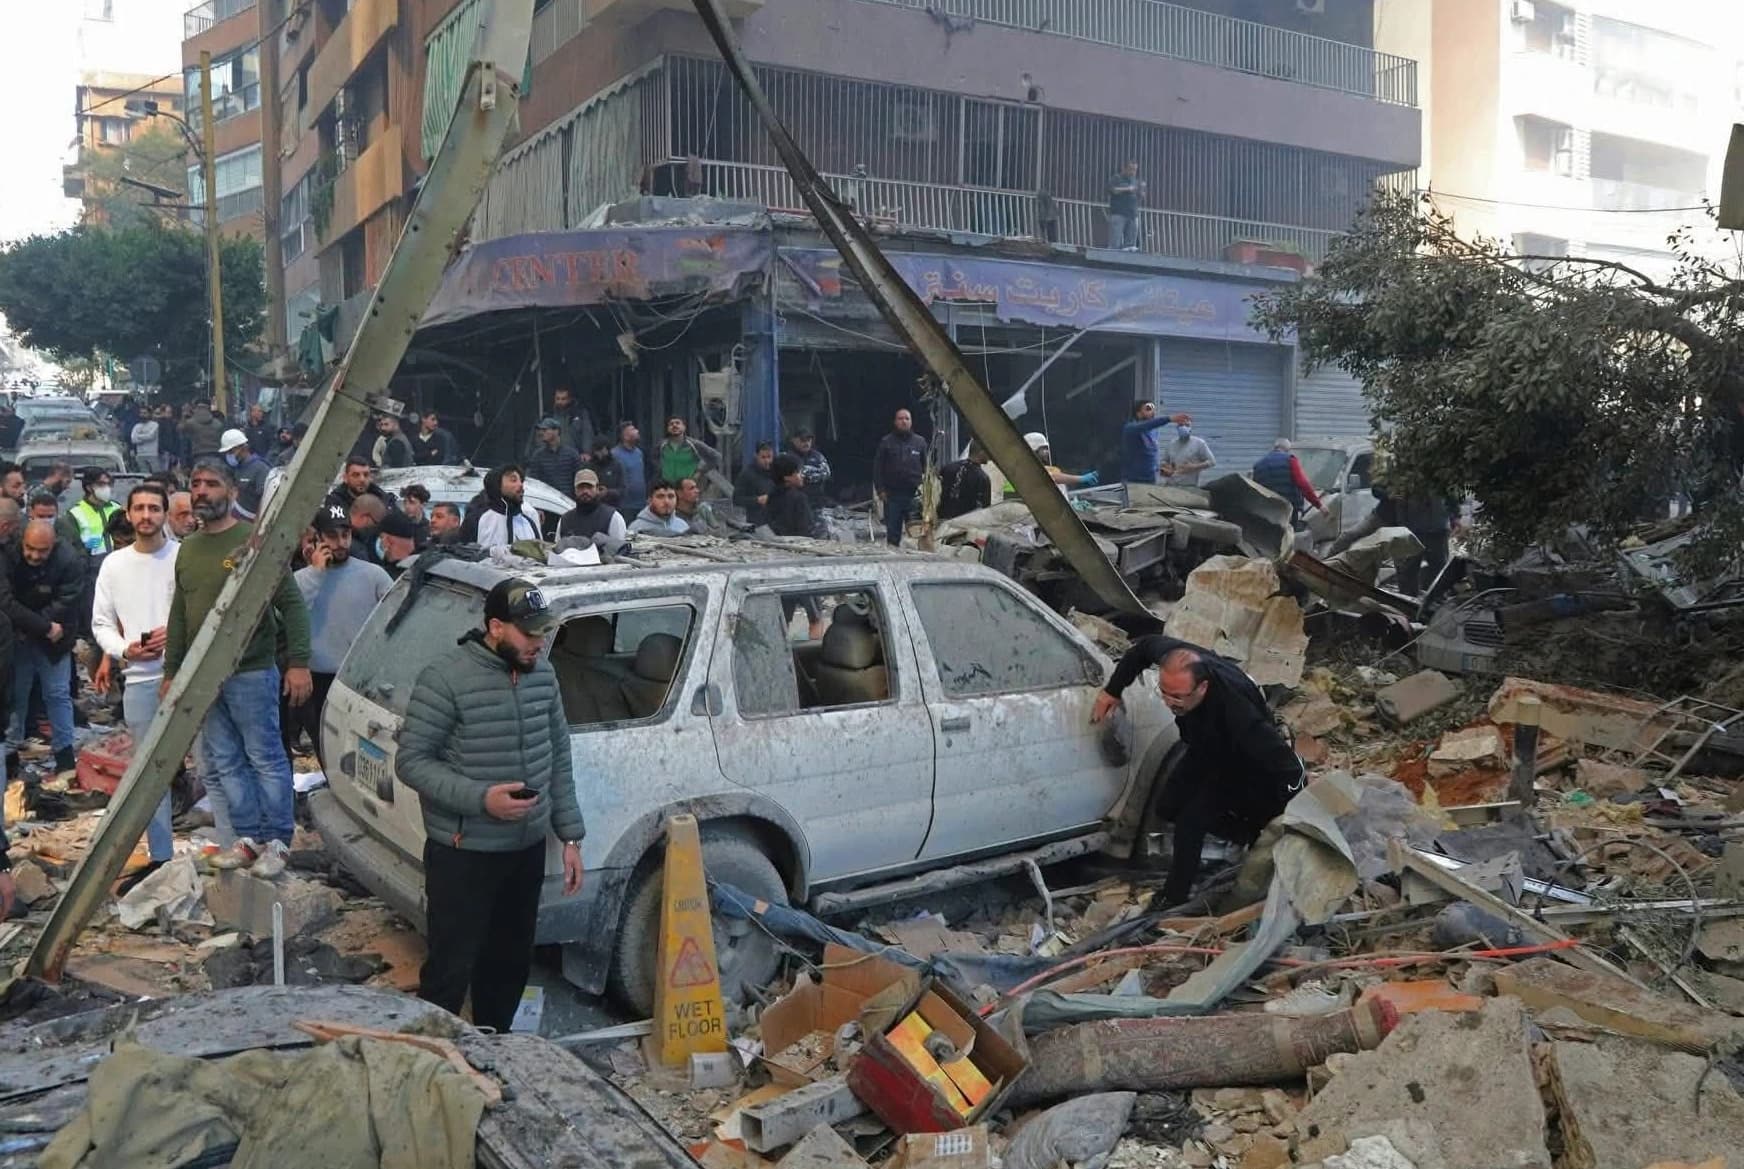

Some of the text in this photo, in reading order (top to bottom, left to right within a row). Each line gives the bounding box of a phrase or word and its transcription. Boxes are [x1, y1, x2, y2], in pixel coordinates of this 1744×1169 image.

[329, 506, 345, 519] NY
[674, 999, 714, 1020] WET
[669, 1017, 721, 1040] FLOOR
